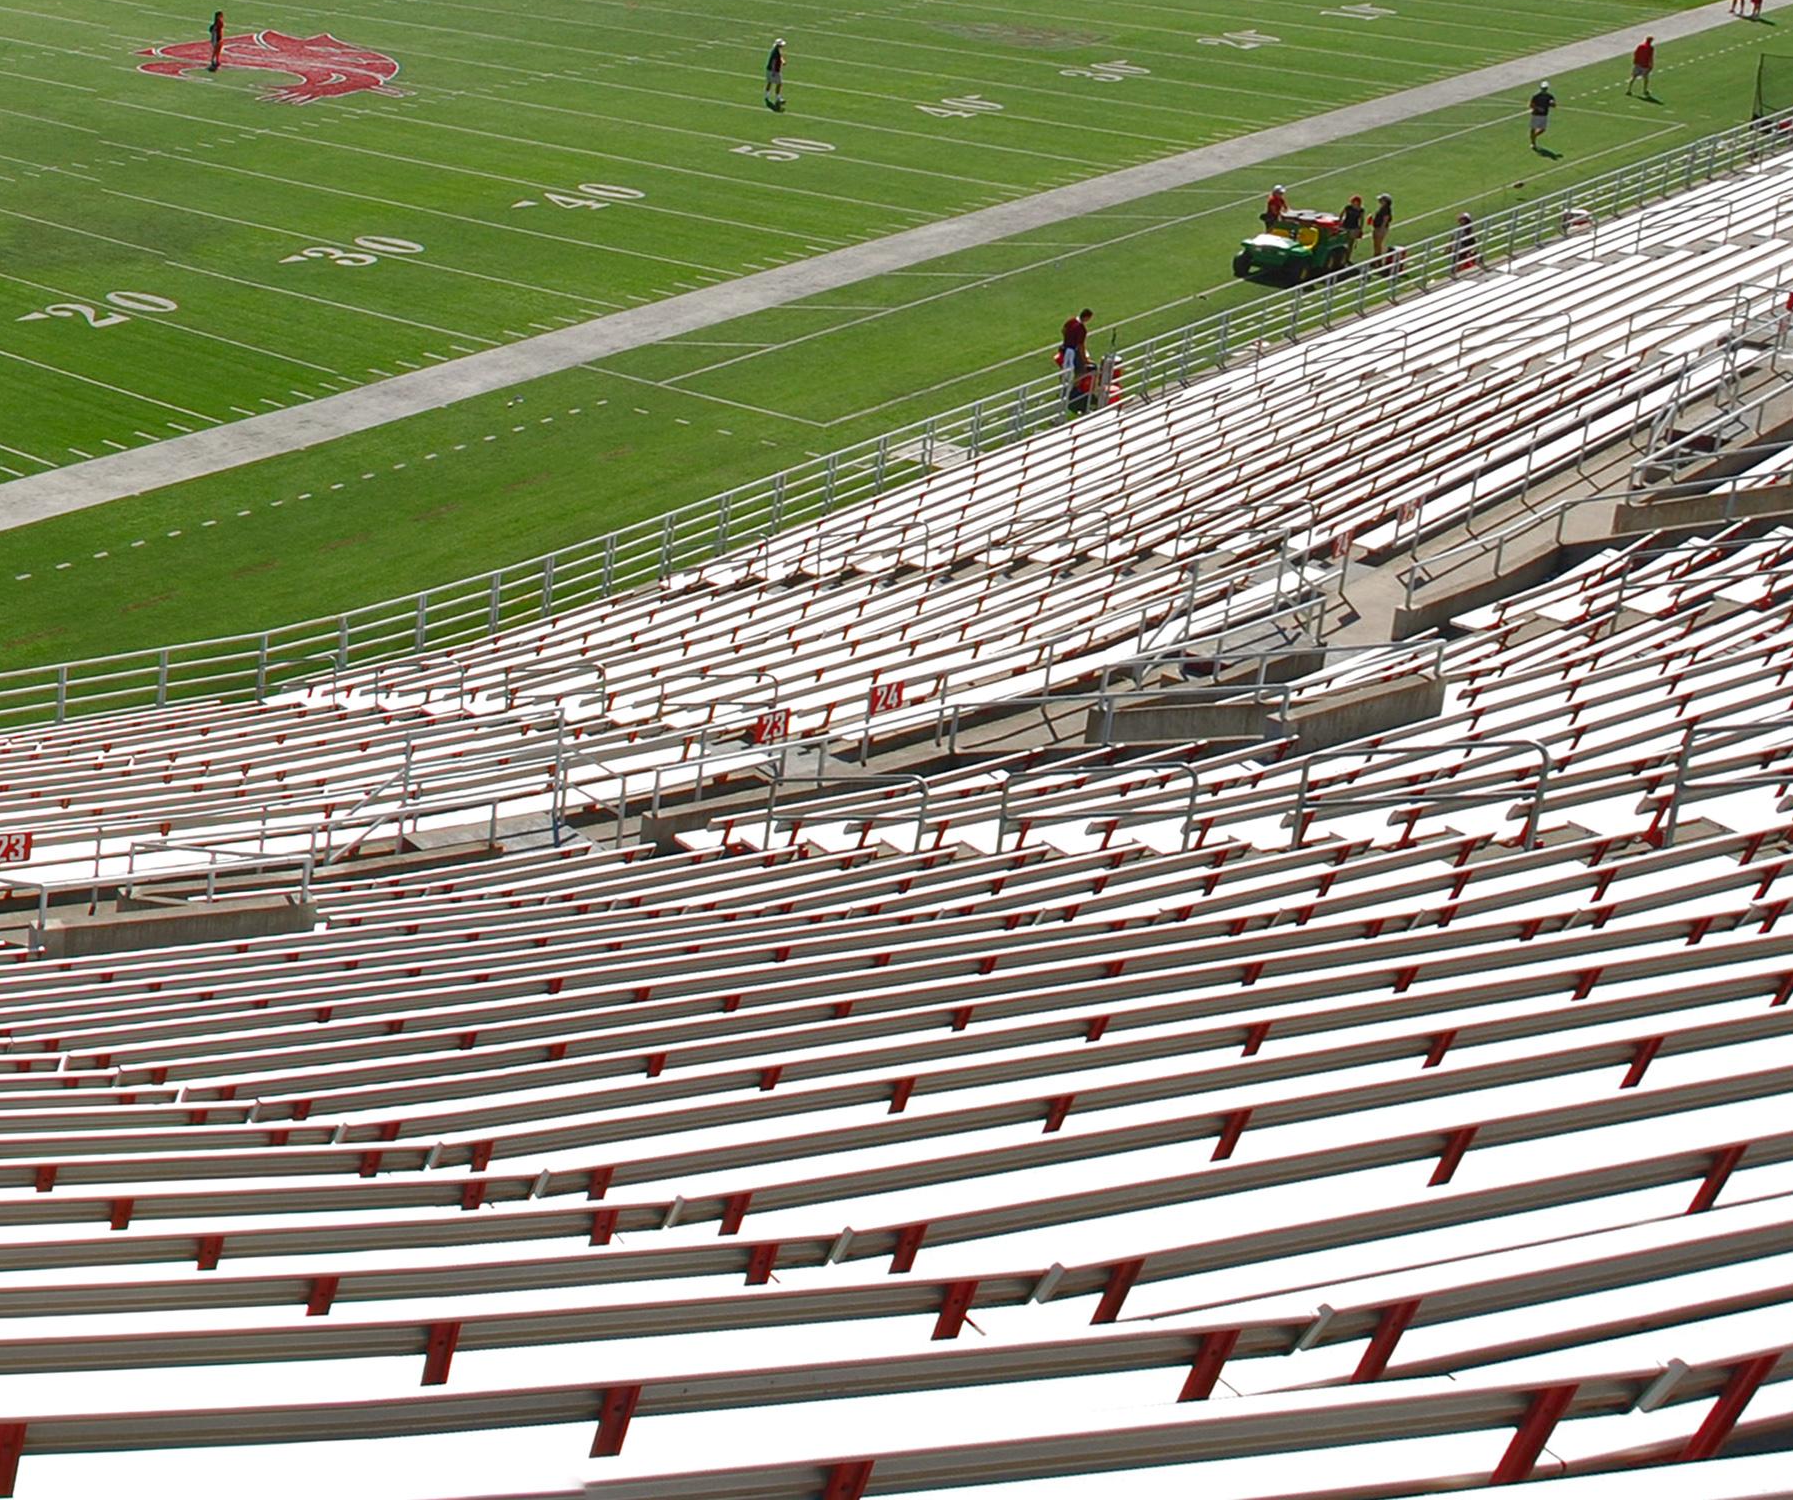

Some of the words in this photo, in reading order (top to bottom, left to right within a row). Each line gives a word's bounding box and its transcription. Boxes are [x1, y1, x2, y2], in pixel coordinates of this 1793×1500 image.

[731, 136, 837, 163] 50
[543, 182, 646, 212] 40
[305, 235, 424, 267] 30
[44, 290, 179, 329] 20
[876, 682, 899, 712] 24
[760, 710, 787, 742] 23
